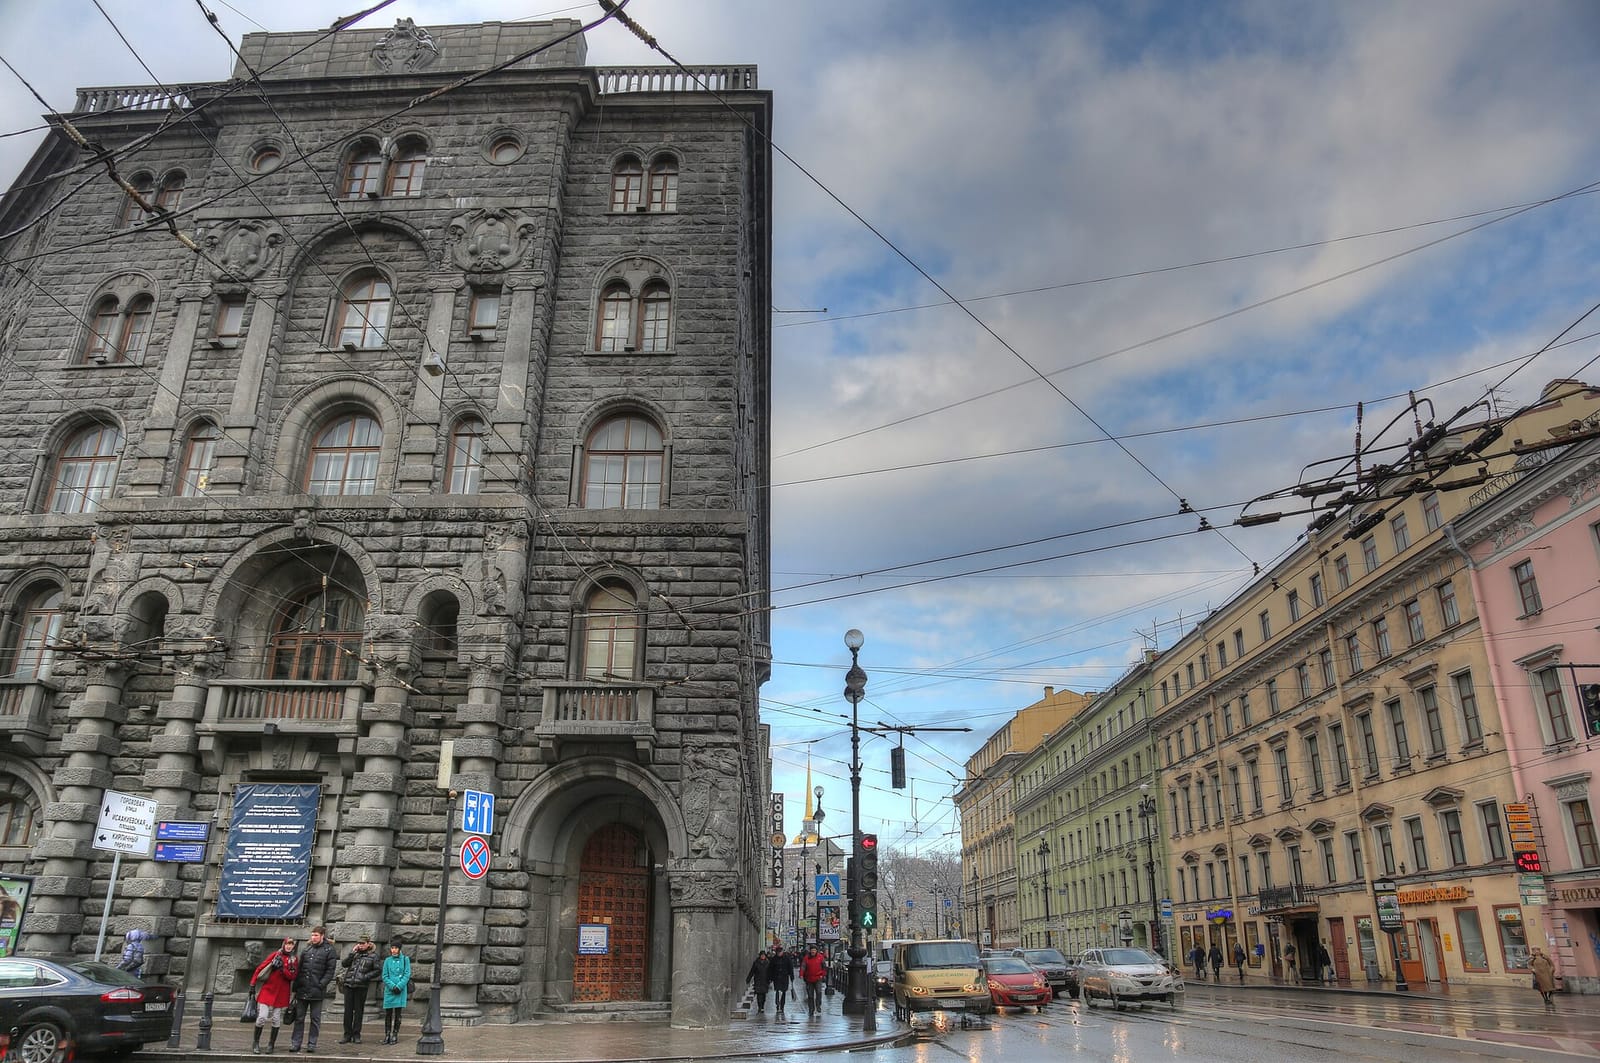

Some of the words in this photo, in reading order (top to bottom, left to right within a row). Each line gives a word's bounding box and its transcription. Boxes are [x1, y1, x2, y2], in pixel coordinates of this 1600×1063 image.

[120, 796, 145, 807] ГОРОХОВАЯ
[774, 794, 783, 831] КОФЕ
[773, 849, 783, 887] ХАУЗ
